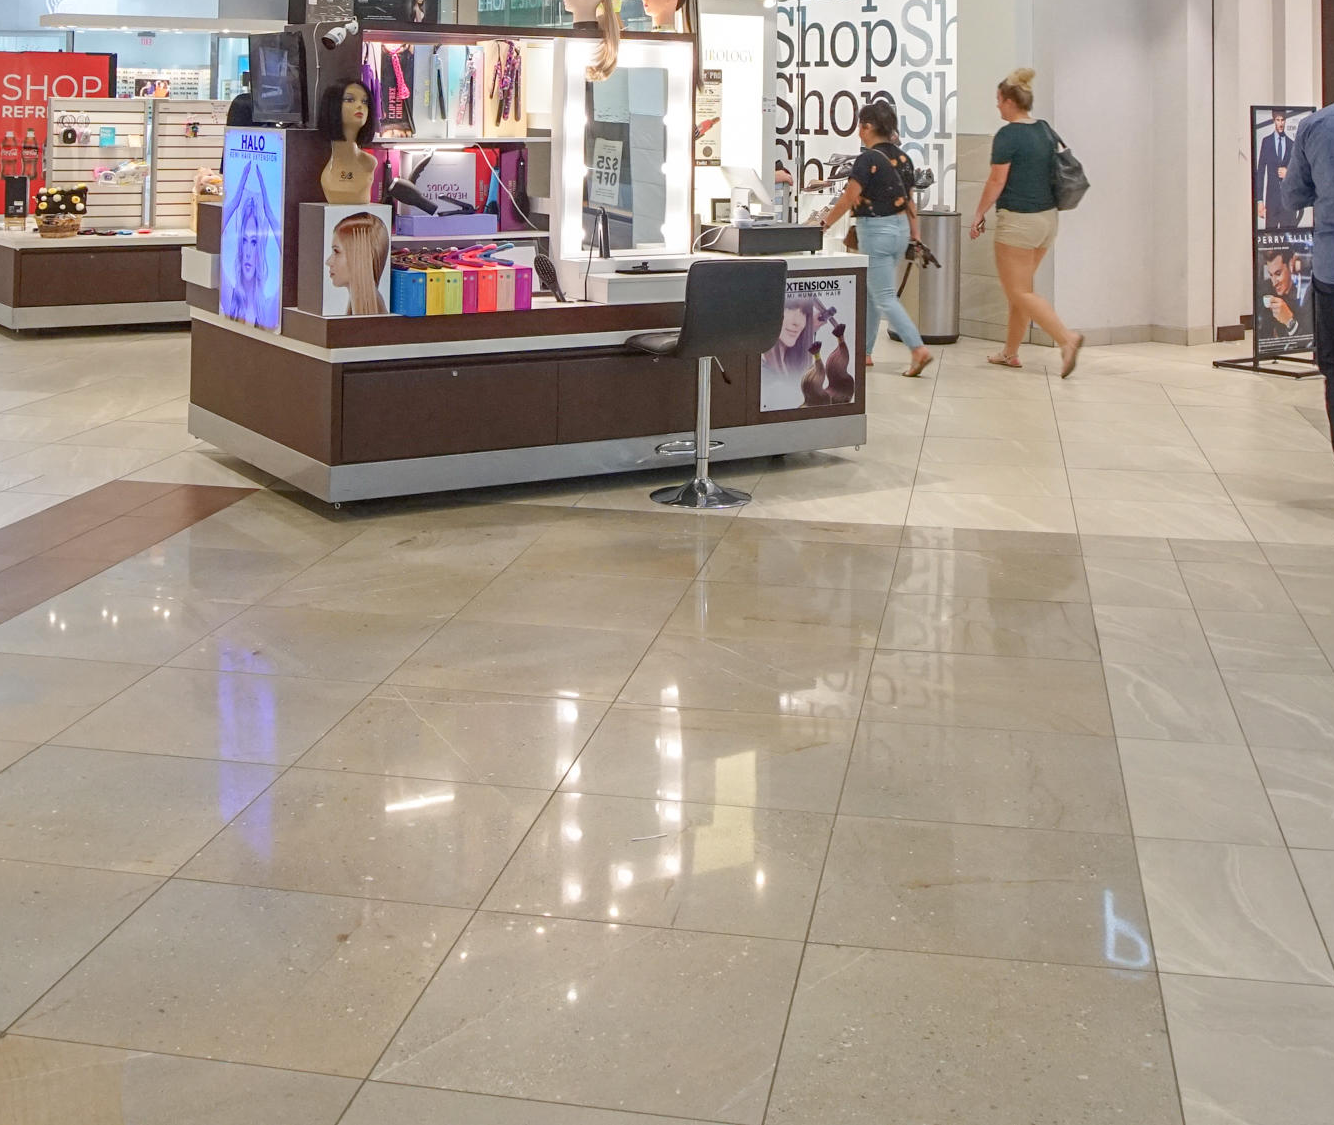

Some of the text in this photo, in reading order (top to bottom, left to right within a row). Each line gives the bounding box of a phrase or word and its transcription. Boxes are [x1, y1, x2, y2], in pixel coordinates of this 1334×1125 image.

[1, 74, 102, 101] SHOP
[2, 105, 49, 118] REFR
[241, 134, 266, 151] HALO
[1257, 236, 1285, 244] PERRY
[786, 280, 839, 291] XTENSIONS
